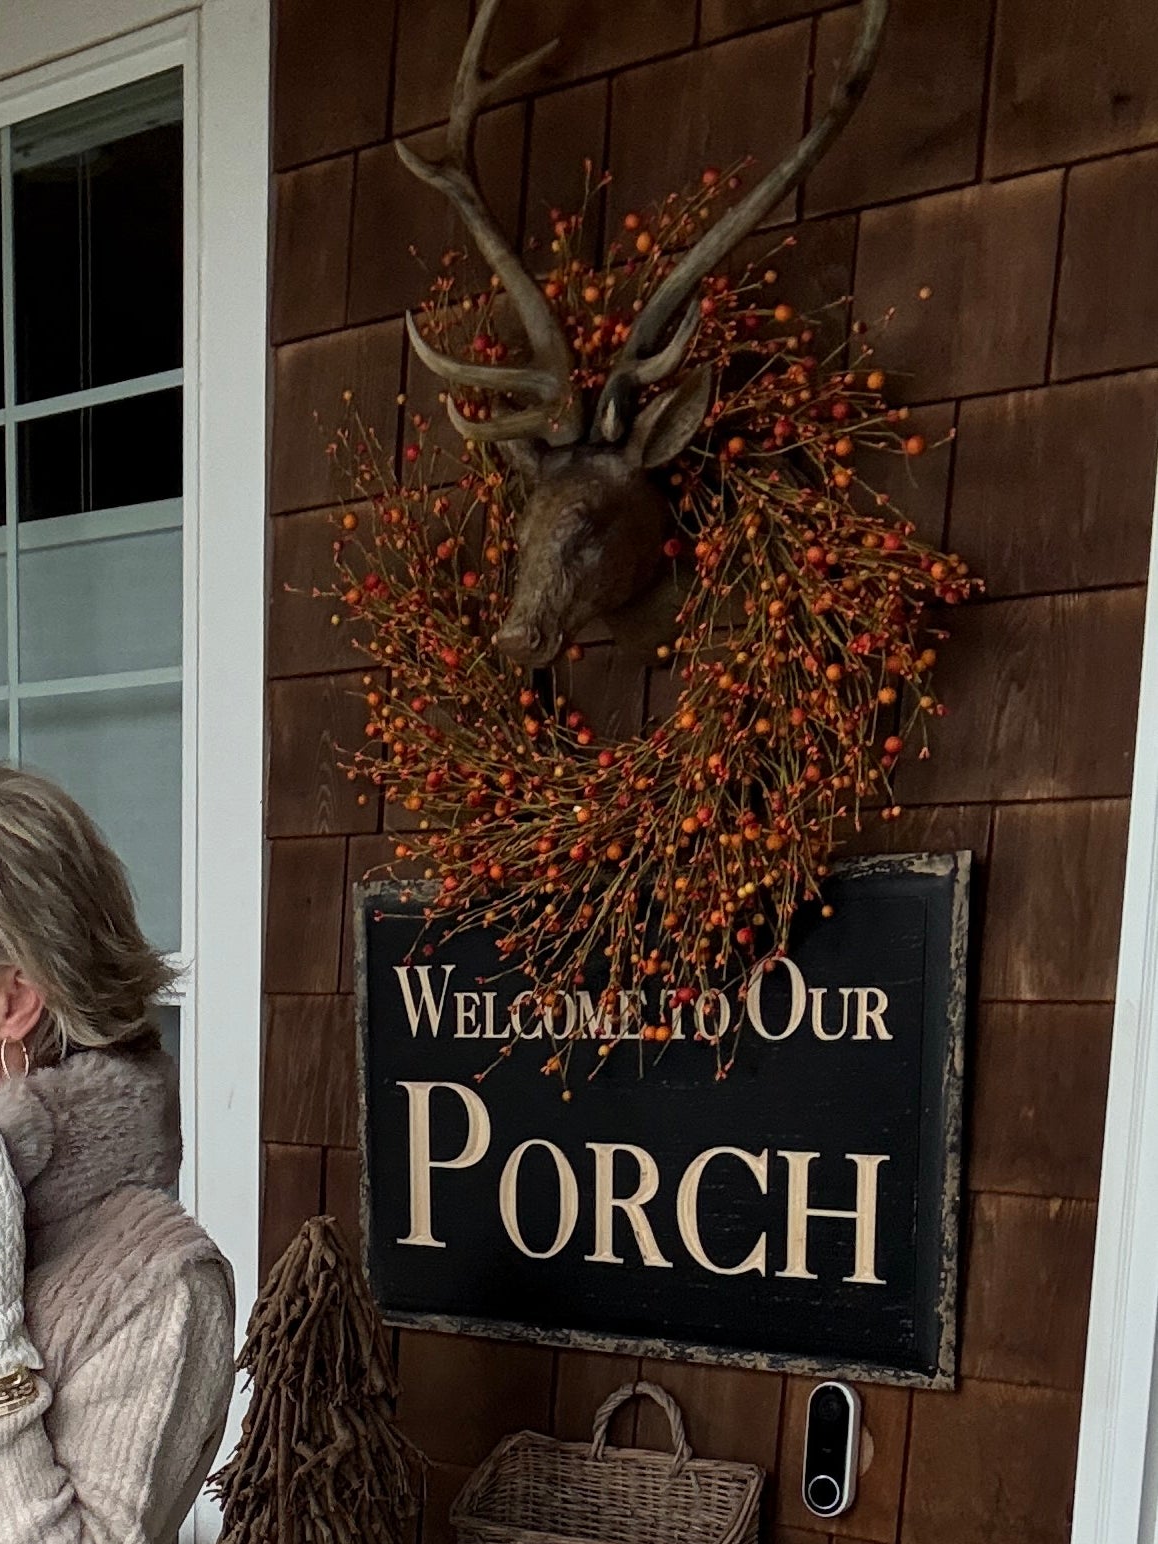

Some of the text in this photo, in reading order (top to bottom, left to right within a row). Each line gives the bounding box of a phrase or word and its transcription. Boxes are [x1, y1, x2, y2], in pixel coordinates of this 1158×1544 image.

[393, 956, 894, 1041] WELCOME TO OUR
[395, 1080, 891, 1285] PORCH
